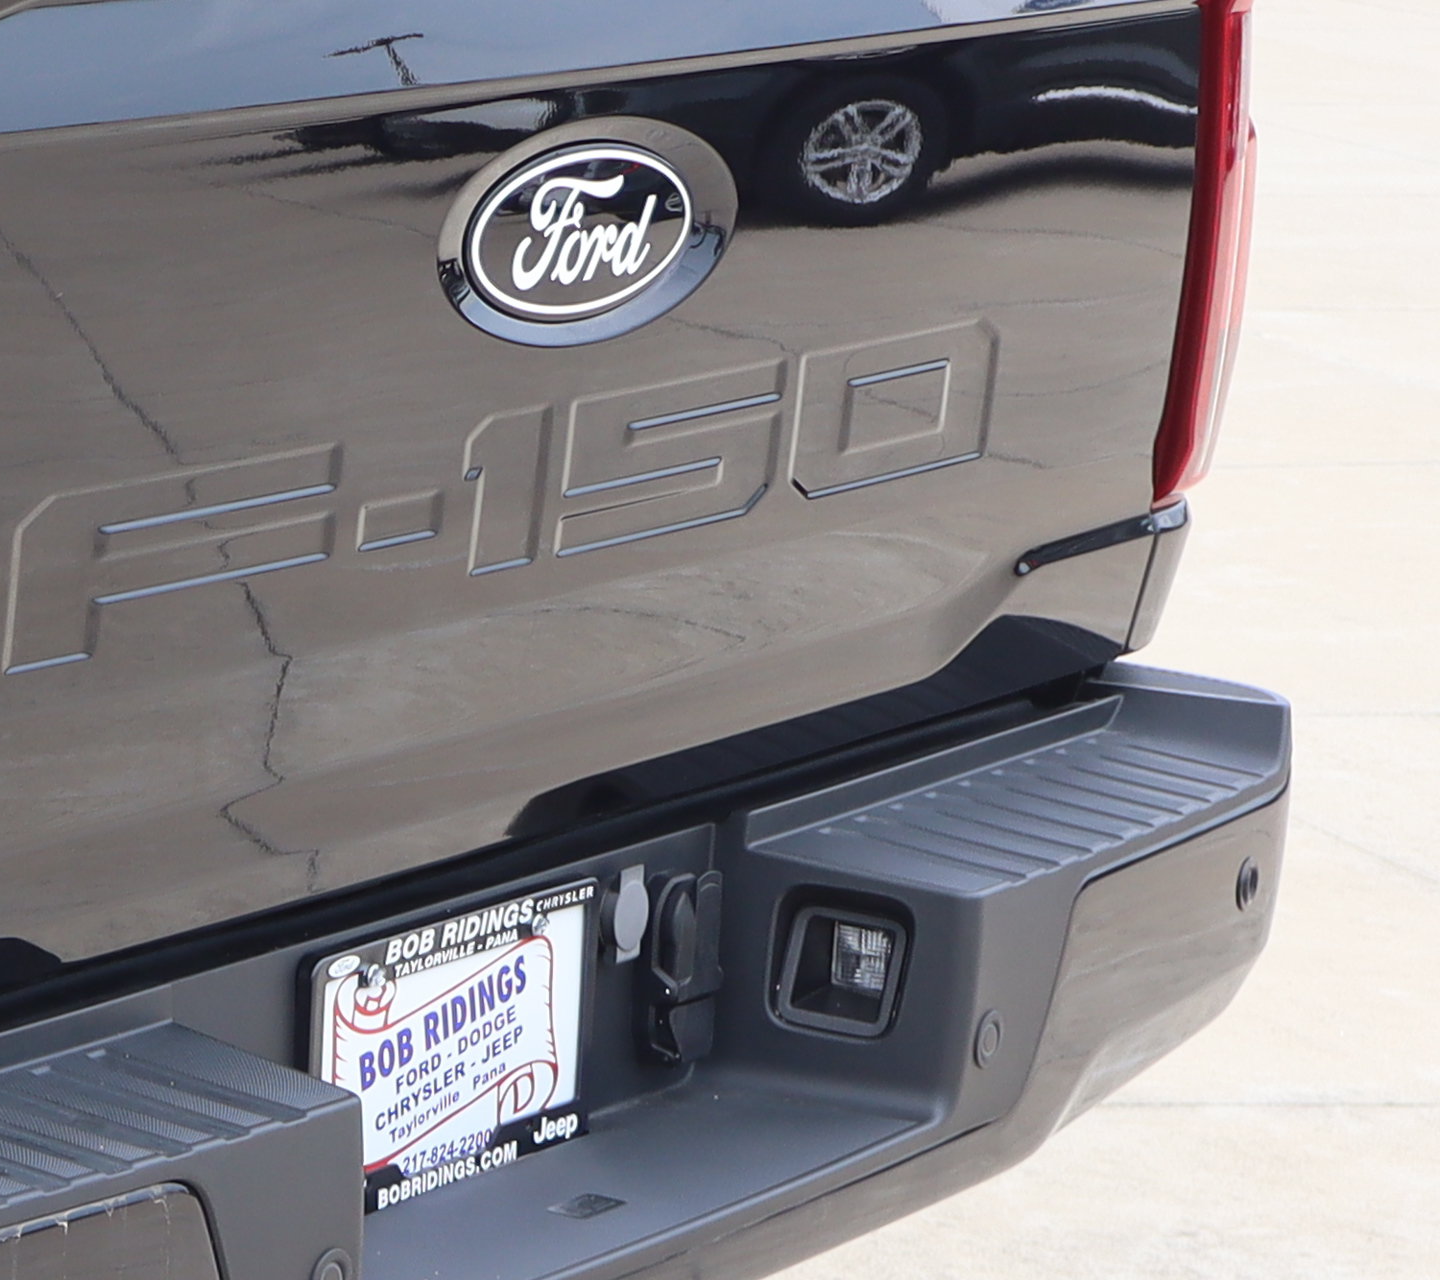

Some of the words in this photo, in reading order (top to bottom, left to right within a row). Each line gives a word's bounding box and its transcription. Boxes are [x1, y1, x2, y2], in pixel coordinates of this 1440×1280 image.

[512, 173, 658, 291] Ford
[2, 319, 1000, 675] F-150
[385, 928, 435, 965] BOB
[441, 898, 534, 948] RIDINGS
[536, 885, 595, 912] CHRYSLER
[394, 942, 475, 978] TAYLORVILLE
[485, 928, 519, 951] PANA
[359, 1027, 414, 1092] BOB
[423, 955, 527, 1051] RIDINGS
[395, 1053, 441, 1095] FORD
[457, 1005, 517, 1055] DODGE
[375, 1061, 465, 1131] CHRYSLER
[482, 1025, 523, 1063] JEEP
[389, 1090, 460, 1144] Taylorville
[473, 1062, 507, 1091] Pana
[401, 1127, 492, 1175] 217-824-2200
[533, 1113, 578, 1144] Jeep
[377, 1140, 518, 1210] BOBRIDINGS.COM
